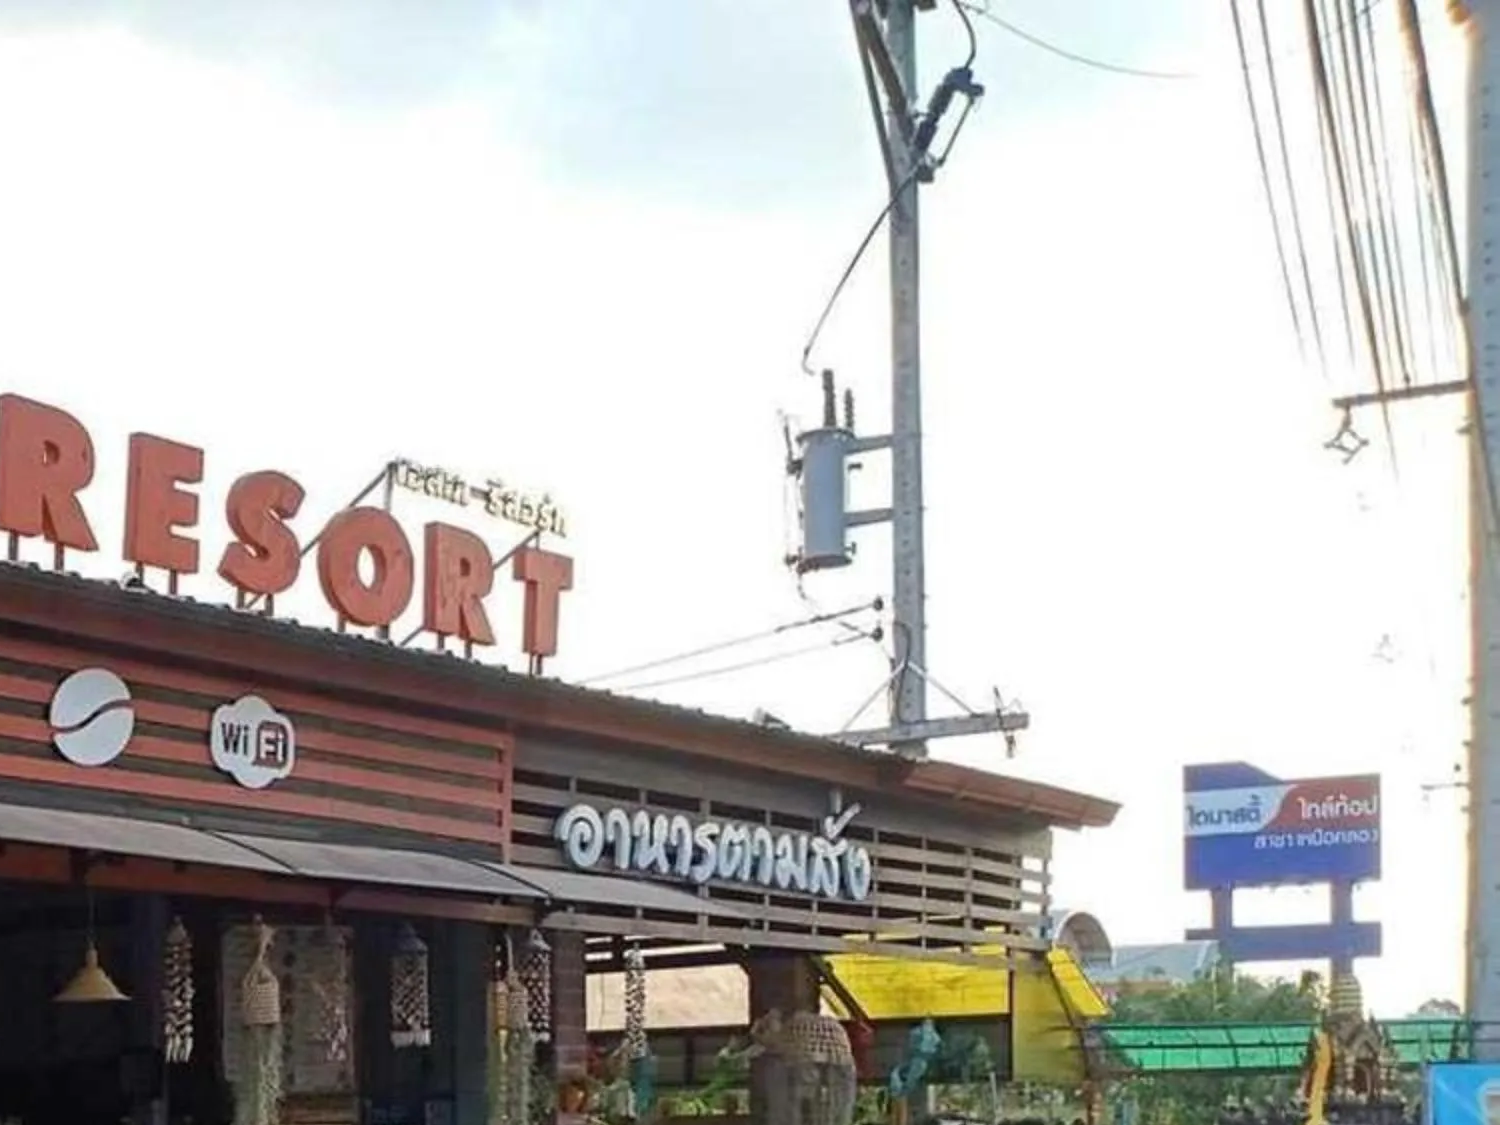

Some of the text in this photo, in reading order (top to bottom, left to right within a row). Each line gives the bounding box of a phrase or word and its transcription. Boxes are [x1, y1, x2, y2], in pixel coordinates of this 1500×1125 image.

[554, 801, 871, 902] อาหารตามสั่ง
